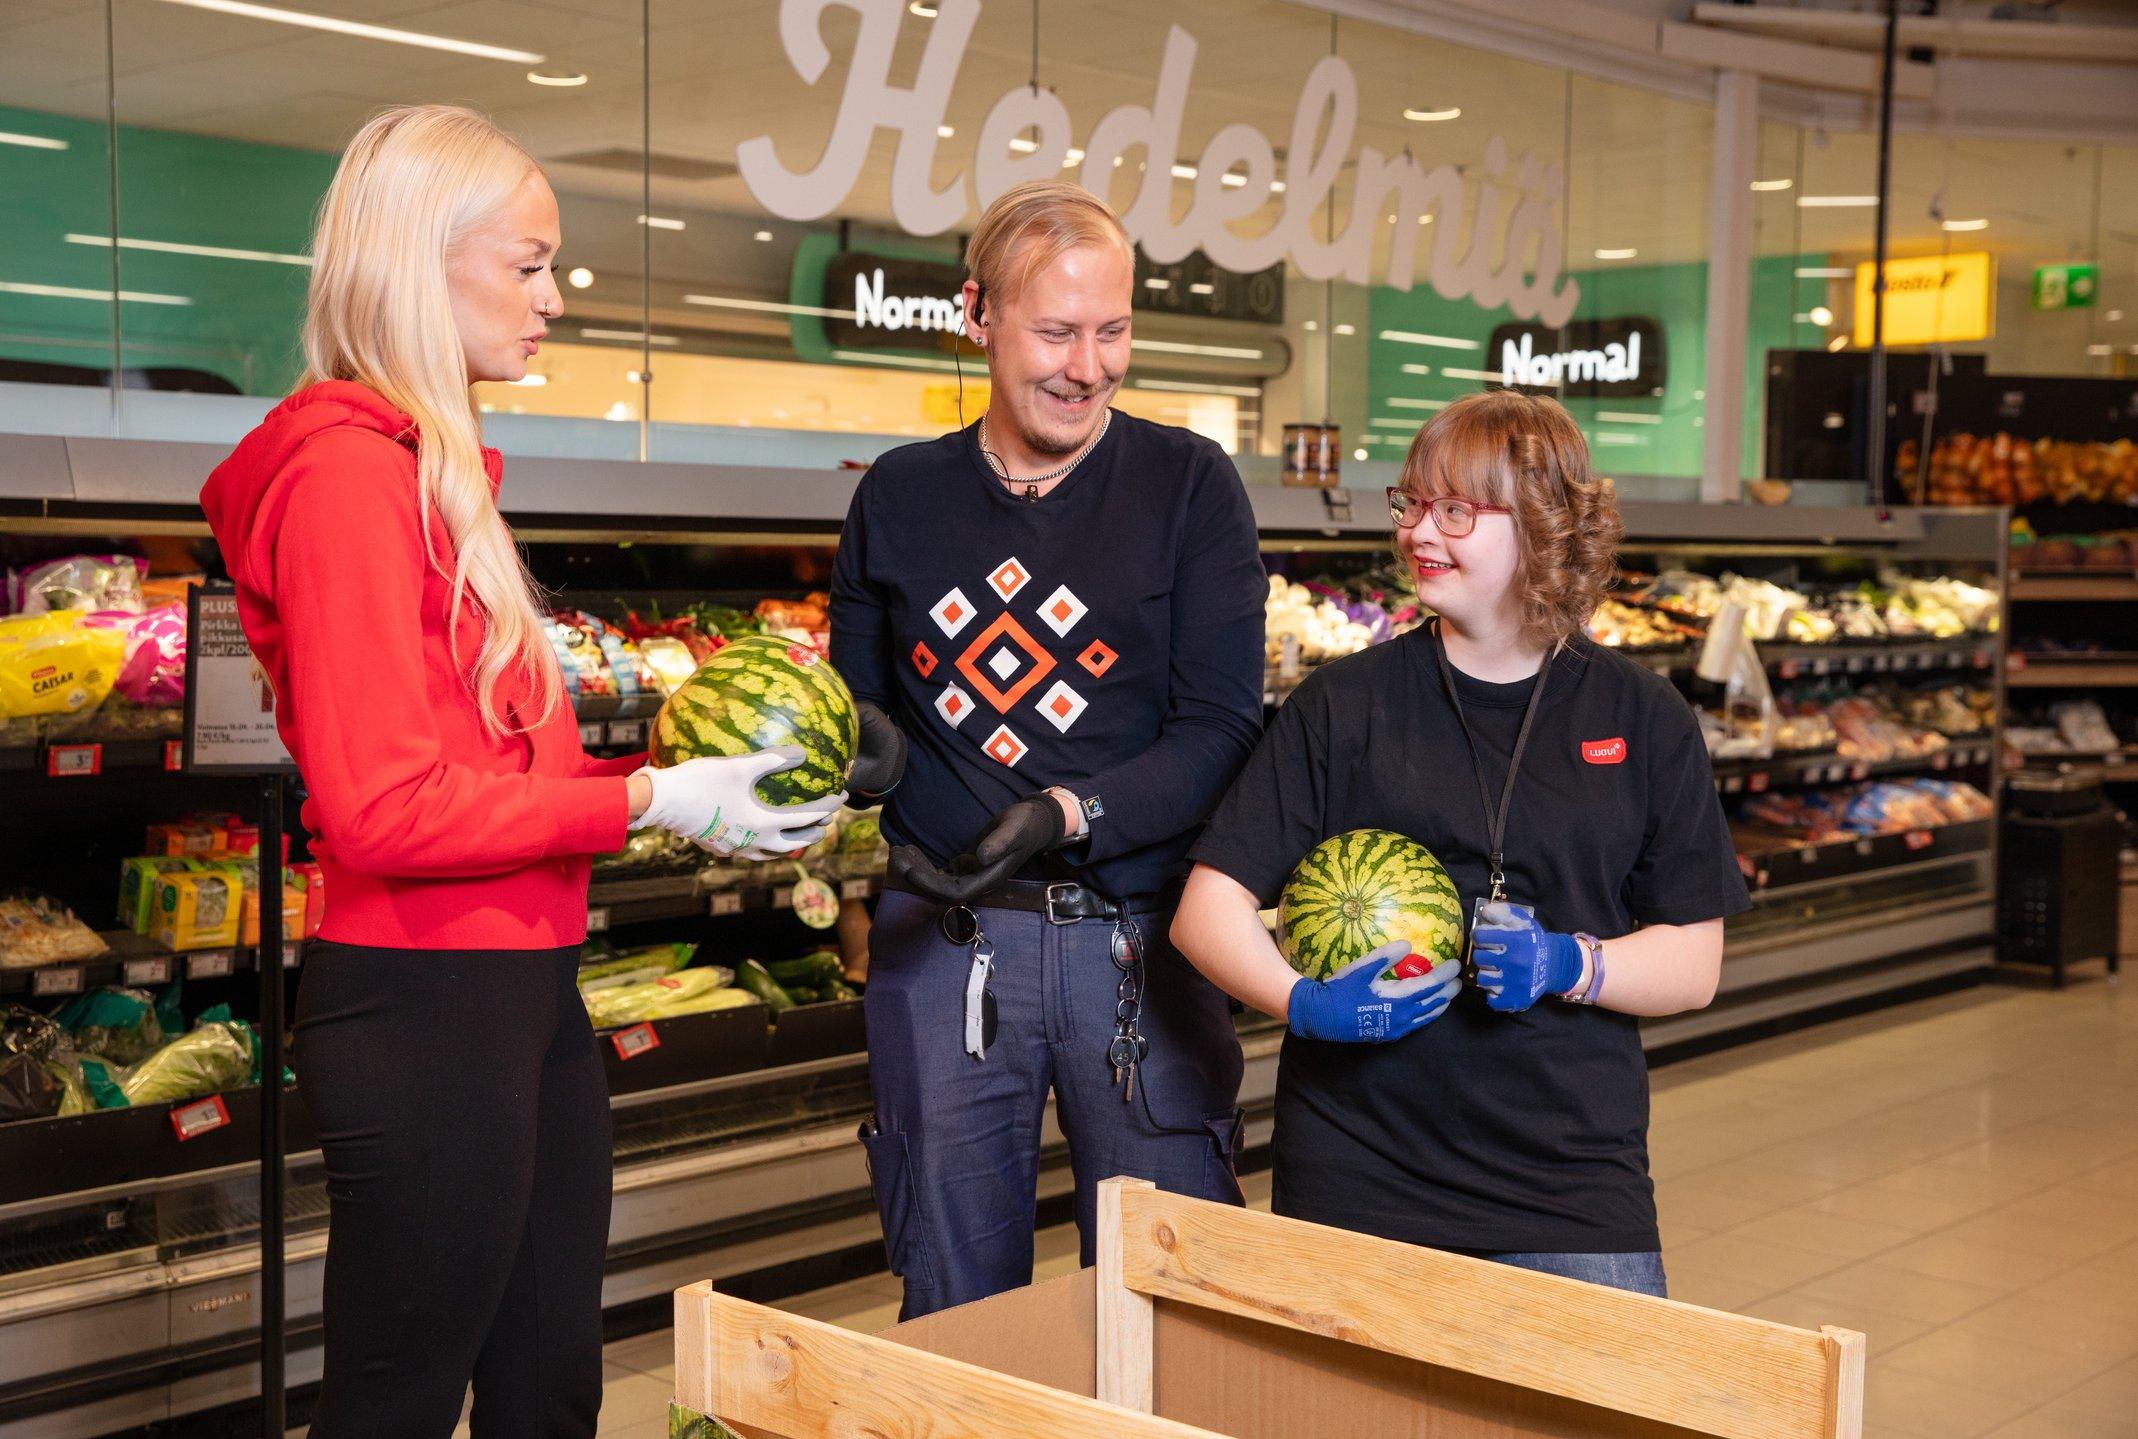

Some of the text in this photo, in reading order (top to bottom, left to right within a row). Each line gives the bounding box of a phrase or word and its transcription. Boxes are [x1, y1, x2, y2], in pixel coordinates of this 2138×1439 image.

[736, 0, 1580, 328] Hedelmiä
[1502, 331, 1641, 387] Normal
[33, 672, 74, 693] CAESAR
